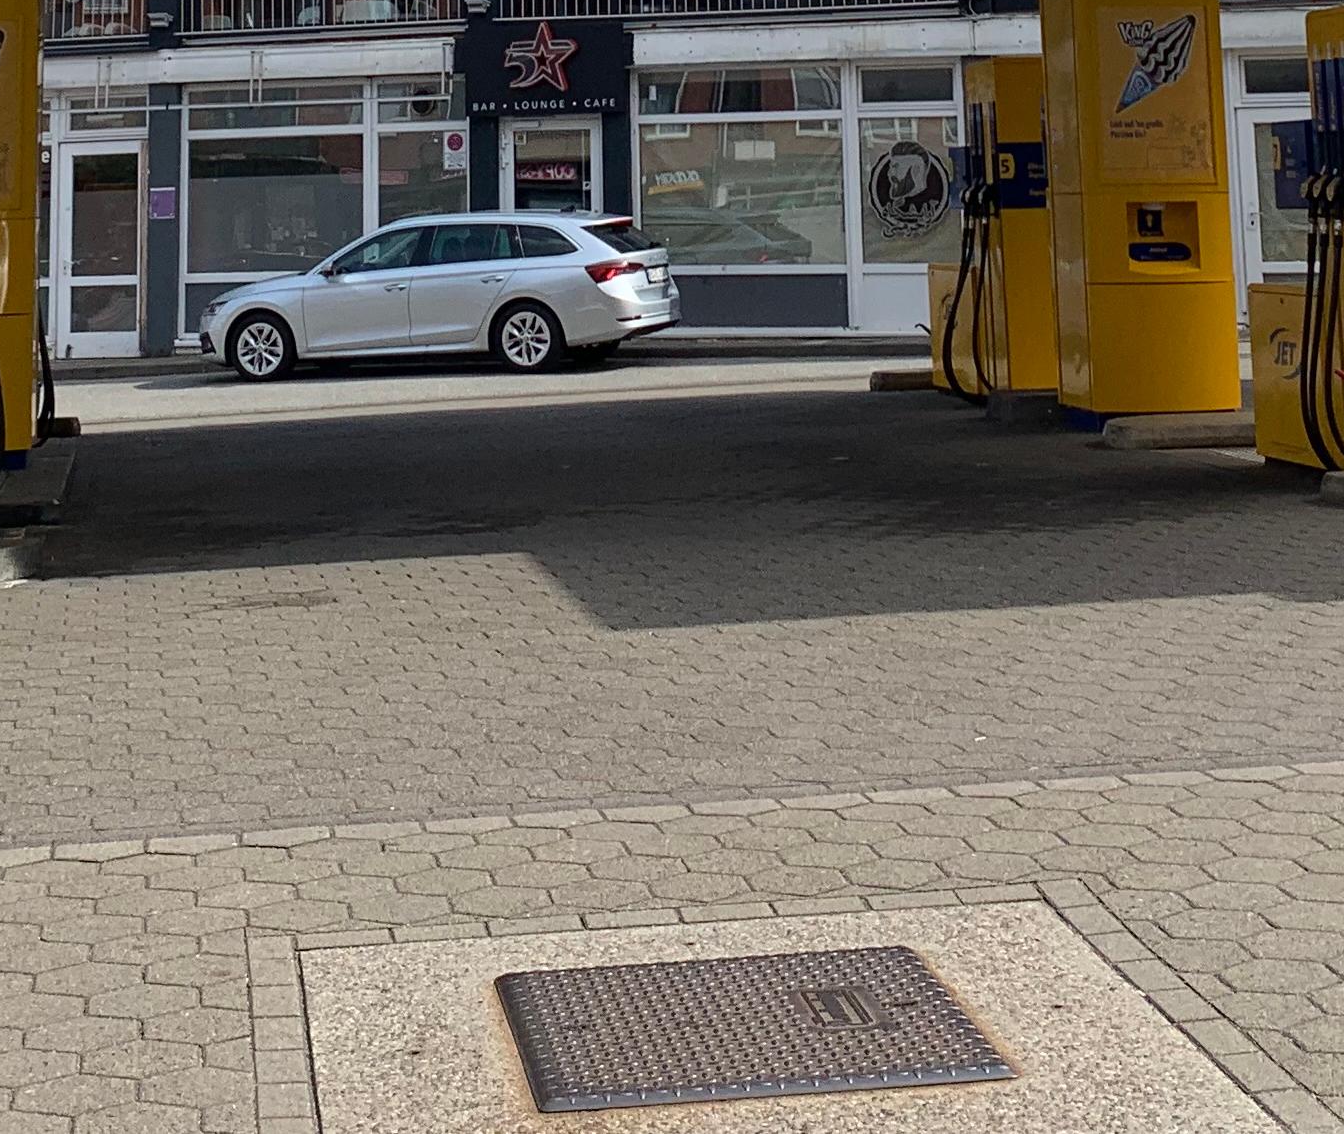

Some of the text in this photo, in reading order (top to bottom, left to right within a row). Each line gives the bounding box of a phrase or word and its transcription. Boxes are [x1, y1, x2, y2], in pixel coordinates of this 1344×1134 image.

[472, 98, 616, 112] BAR LOUNGE CAFE
[1001, 159, 1010, 174] 5
[1274, 340, 1297, 366] JET
